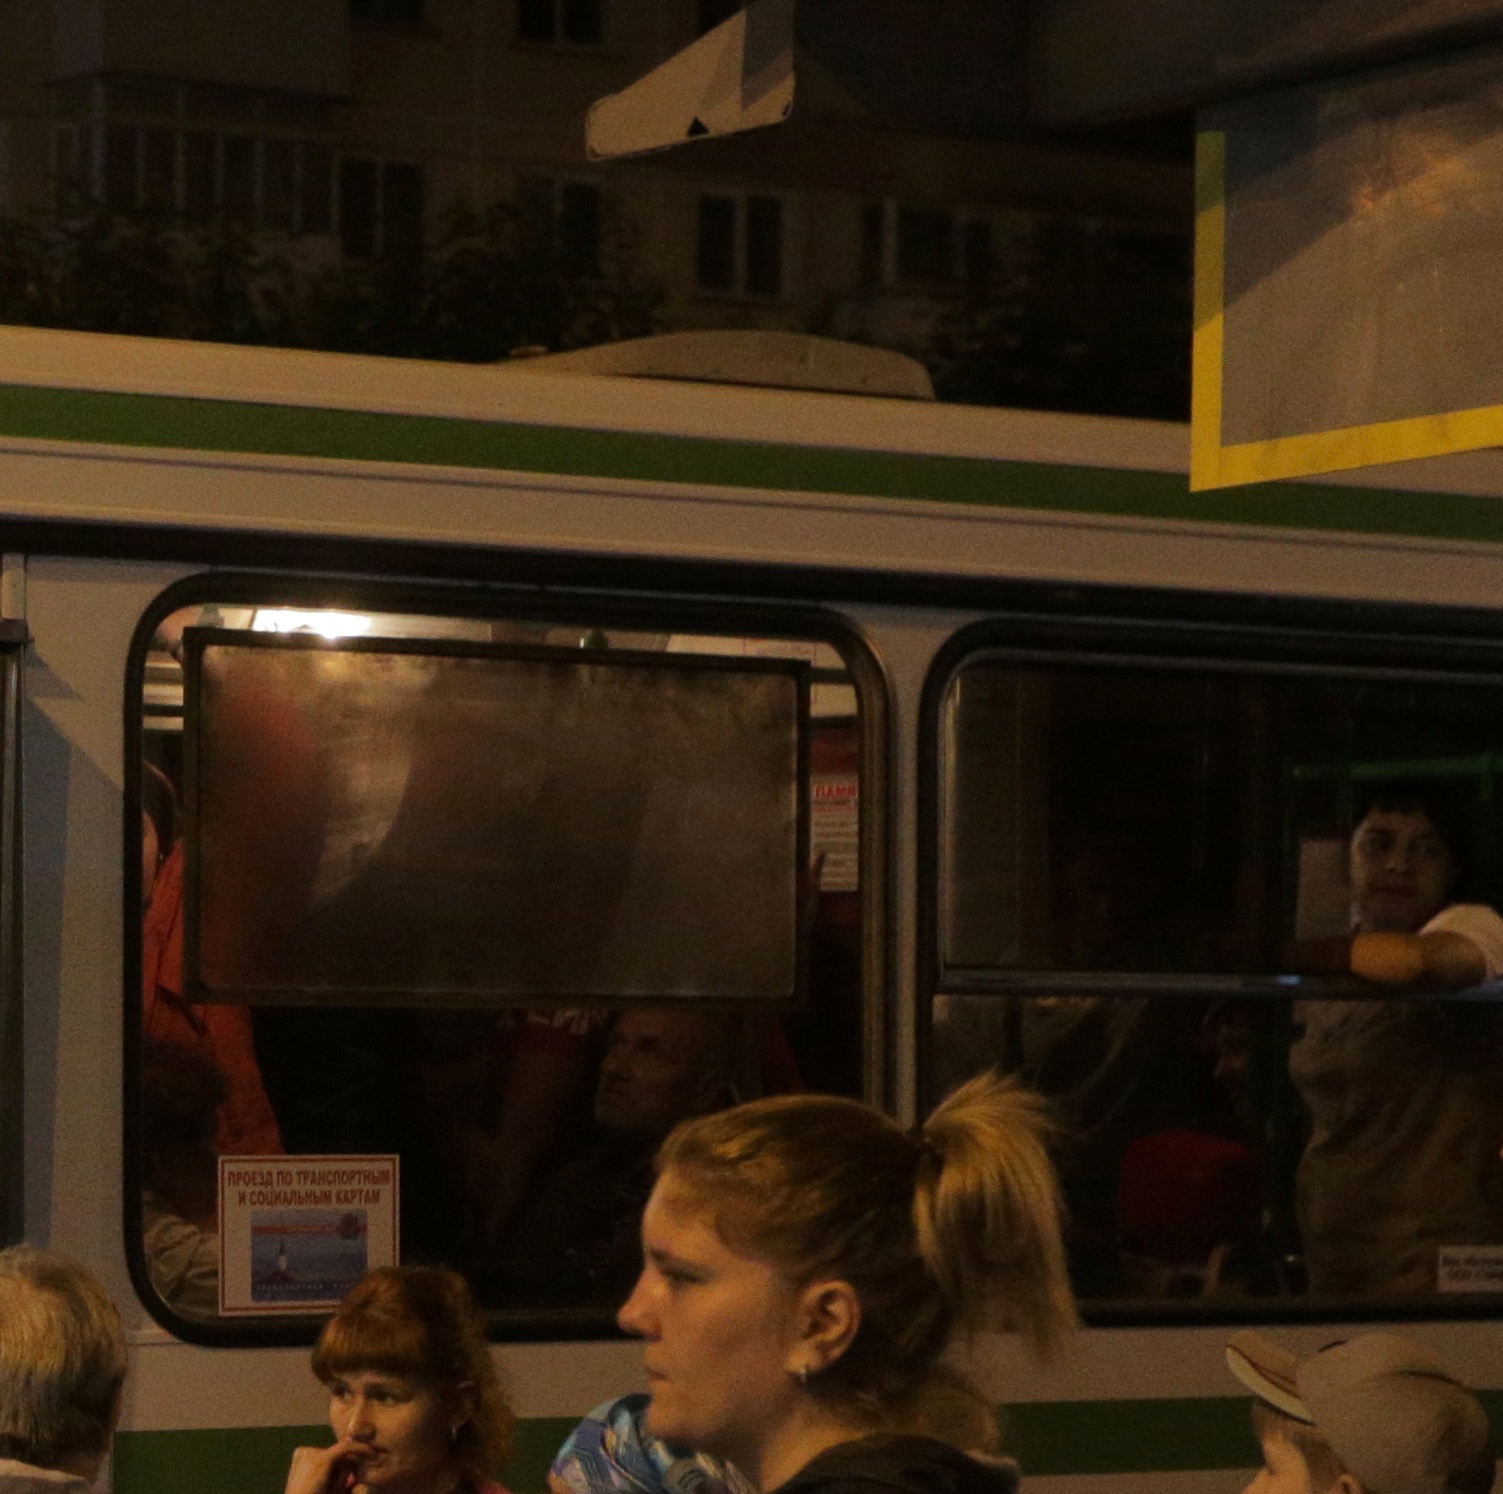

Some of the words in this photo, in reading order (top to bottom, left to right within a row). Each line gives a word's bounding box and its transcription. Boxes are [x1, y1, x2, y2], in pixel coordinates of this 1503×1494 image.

[227, 1171, 274, 1189] ПРОЕЗД
[277, 1170, 292, 1186] ПО
[297, 1169, 391, 1187] ТРАНСПОРТНЫМ
[238, 1191, 249, 1206] И
[249, 1190, 333, 1207] СОЦИАЛЬНЫМ
[336, 1189, 381, 1205] КАРТАМ
